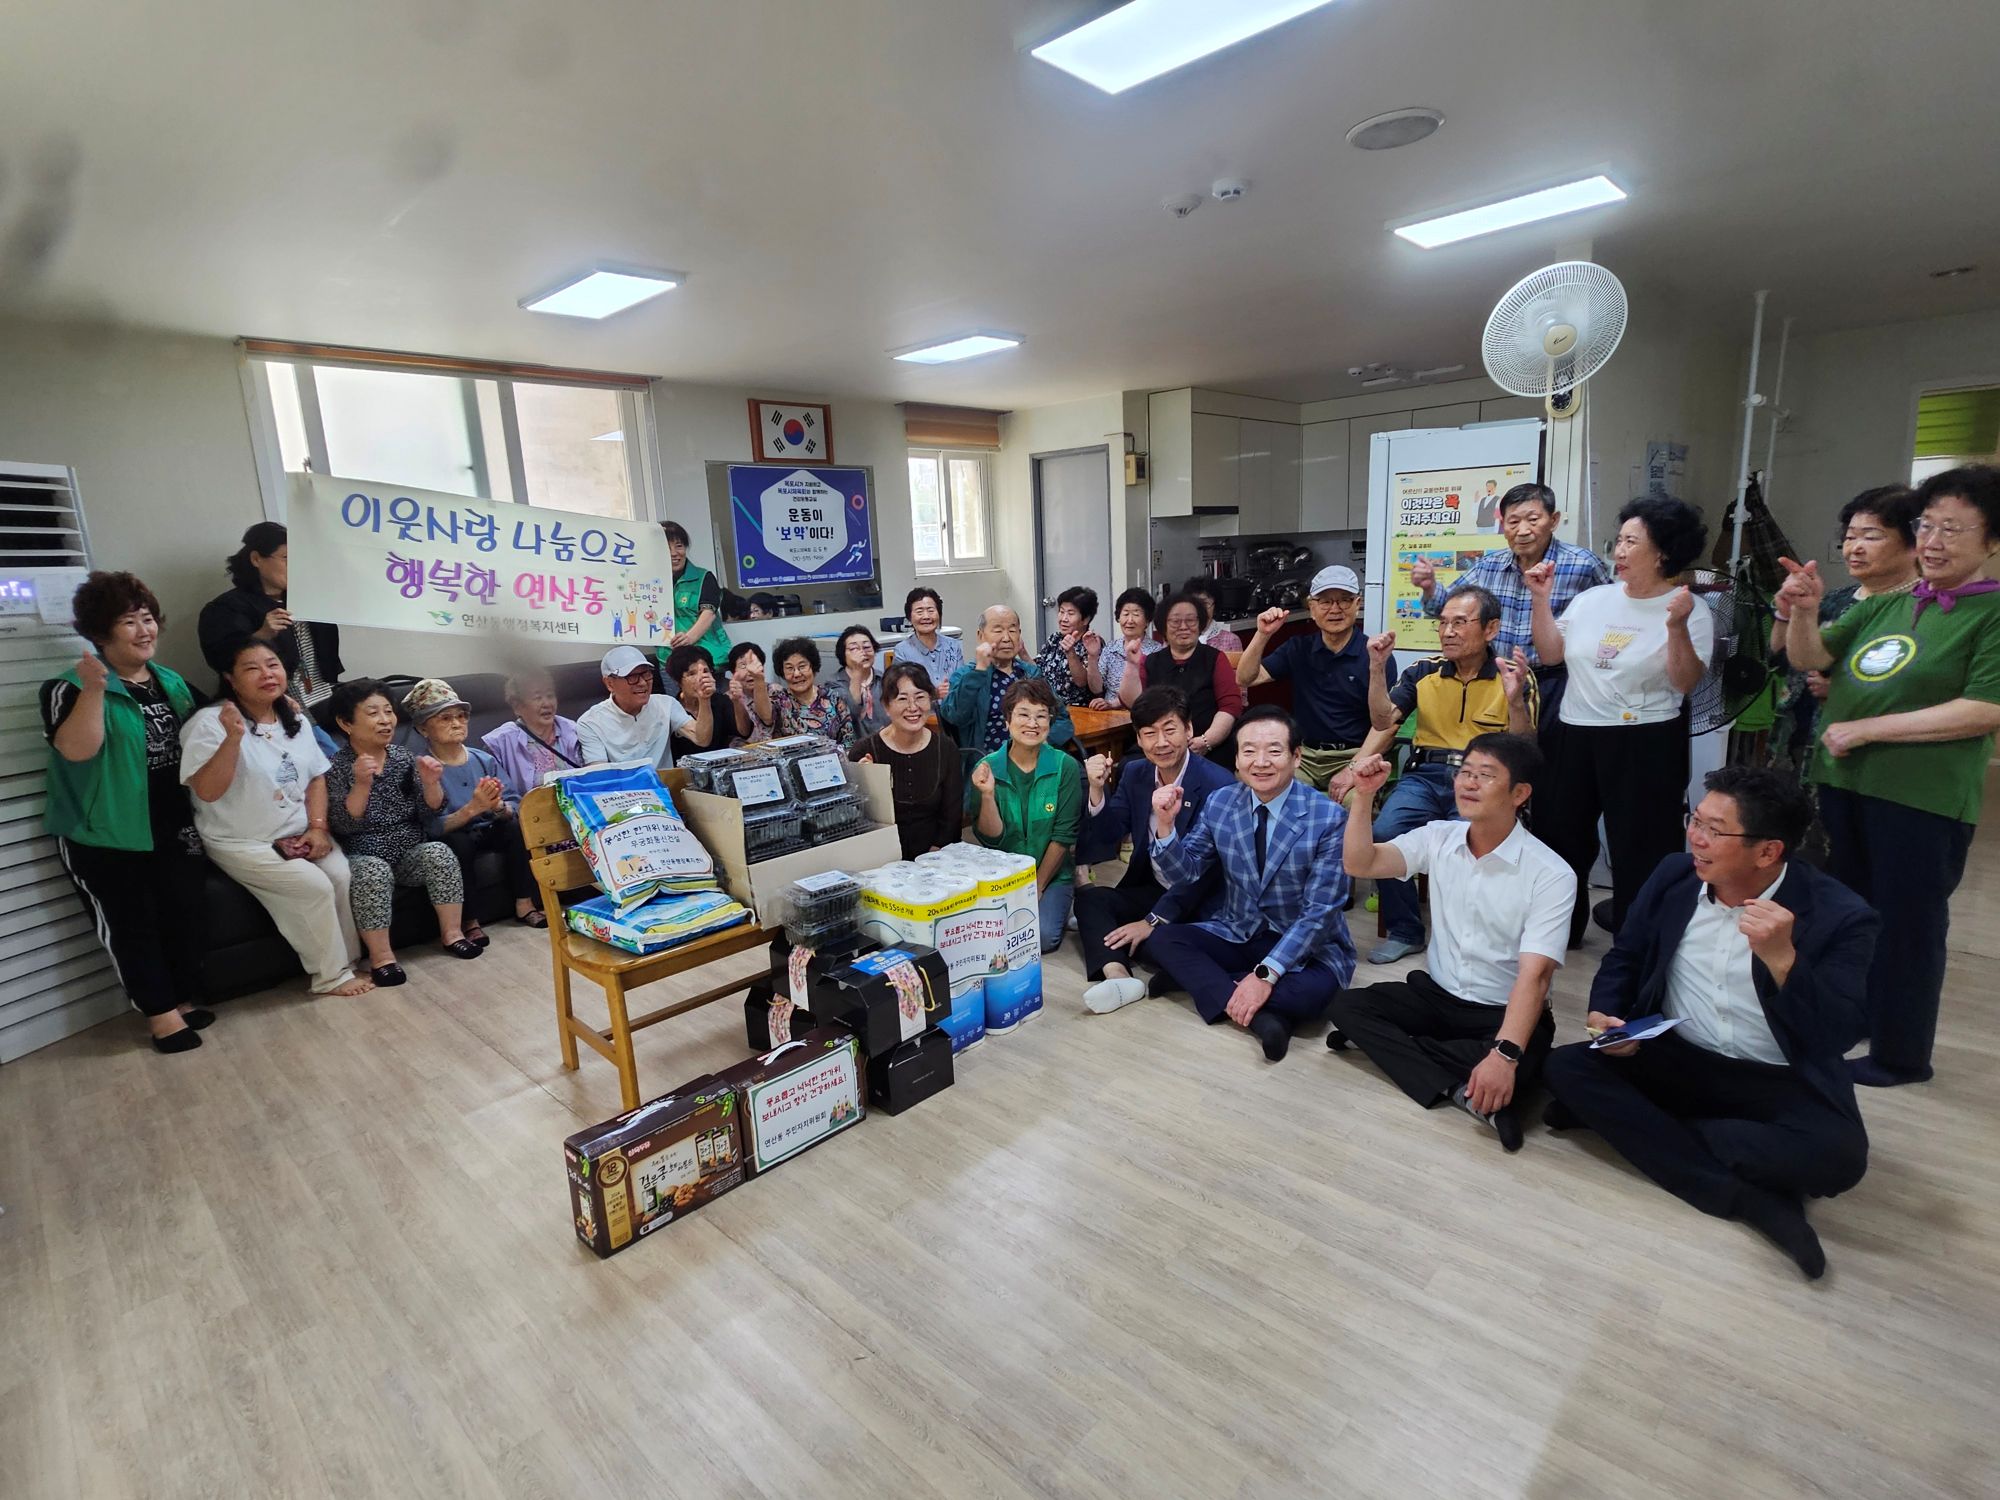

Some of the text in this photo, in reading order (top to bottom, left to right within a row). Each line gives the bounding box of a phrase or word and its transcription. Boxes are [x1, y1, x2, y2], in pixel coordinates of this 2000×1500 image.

[1402, 494, 1460, 510] 이것만은 꼭
[788, 508, 822, 522] 운동이
[1400, 511, 1460, 525] 지켜주세요!!
[341, 493, 638, 566] 이웃사랑 나눔으로
[385, 551, 608, 616] 행복한 연산동
[624, 594, 658, 604] 나누어요
[604, 829, 632, 846] 풍성한
[634, 823, 660, 836] 한가위
[940, 936, 962, 949] 보내시고
[762, 1072, 847, 1122] 보내시고 항상 건강하세요!
[766, 1065, 841, 1108] 풍요롭고 넉넉한 한가위
[764, 1110, 827, 1148] 연산동 주민자치위원회
[639, 1164, 668, 1190] 검은콩
